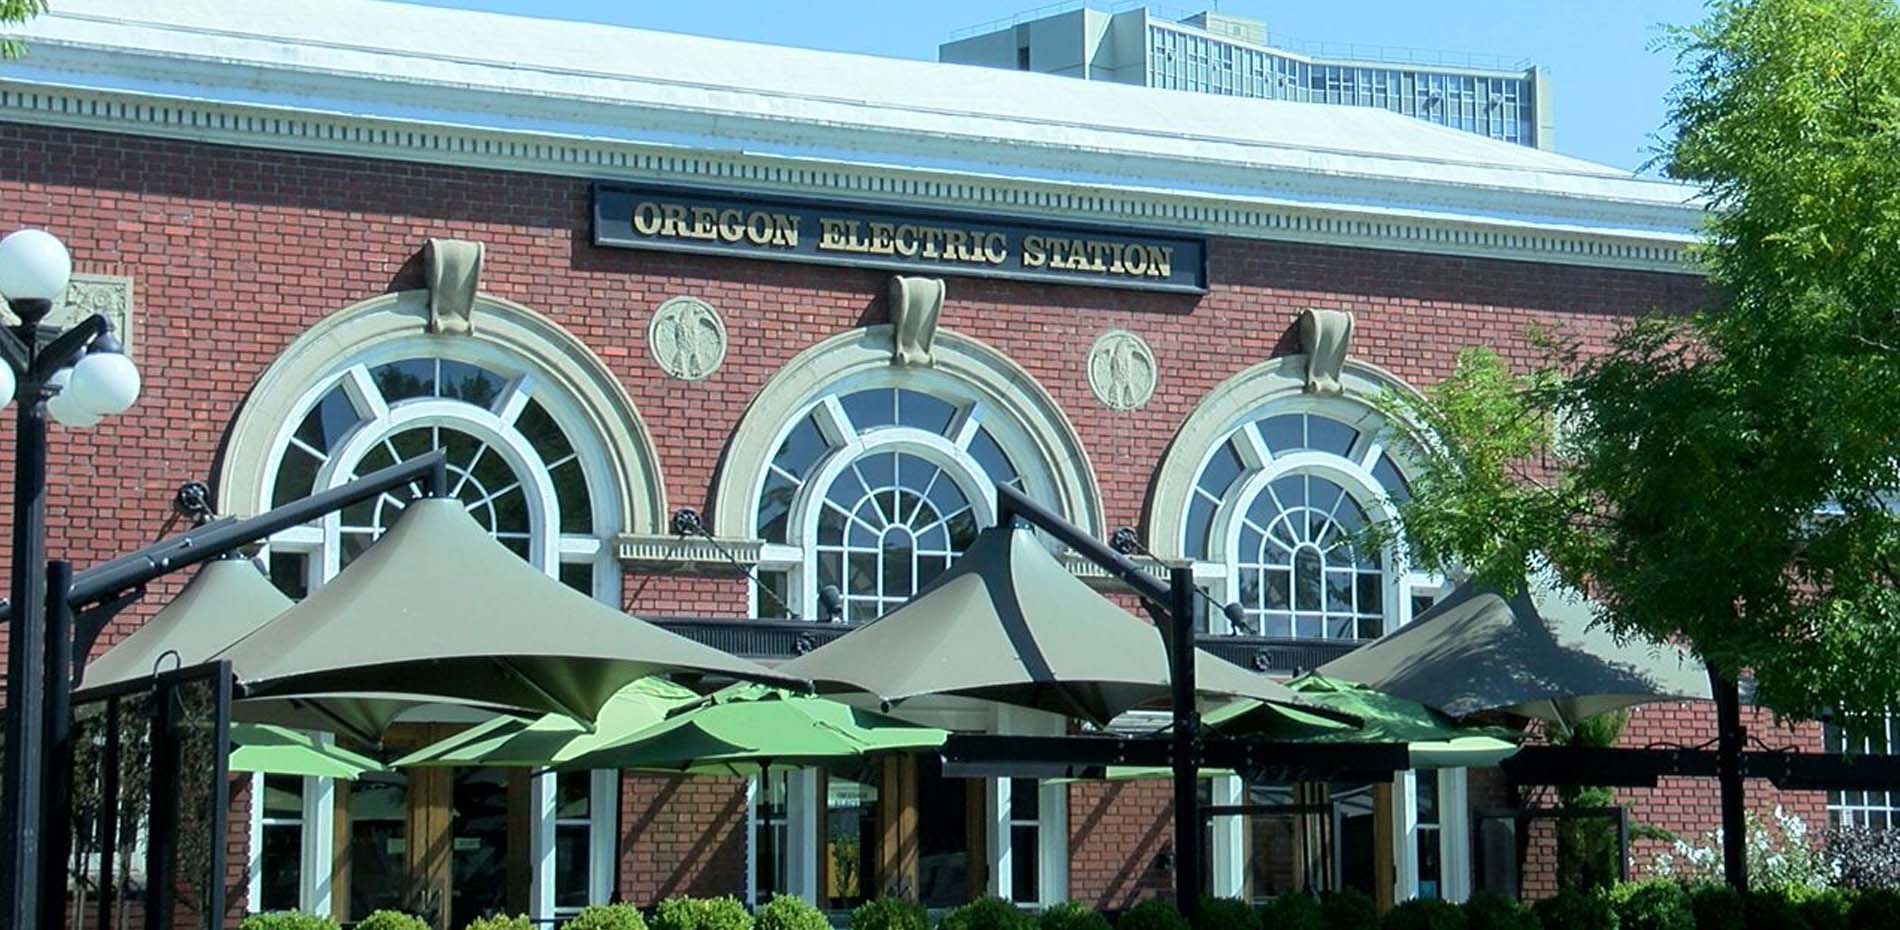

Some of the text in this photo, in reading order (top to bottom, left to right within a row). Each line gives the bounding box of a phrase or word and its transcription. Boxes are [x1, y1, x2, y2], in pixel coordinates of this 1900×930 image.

[634, 202, 1173, 277] OREGON ELECTRIC STATION
